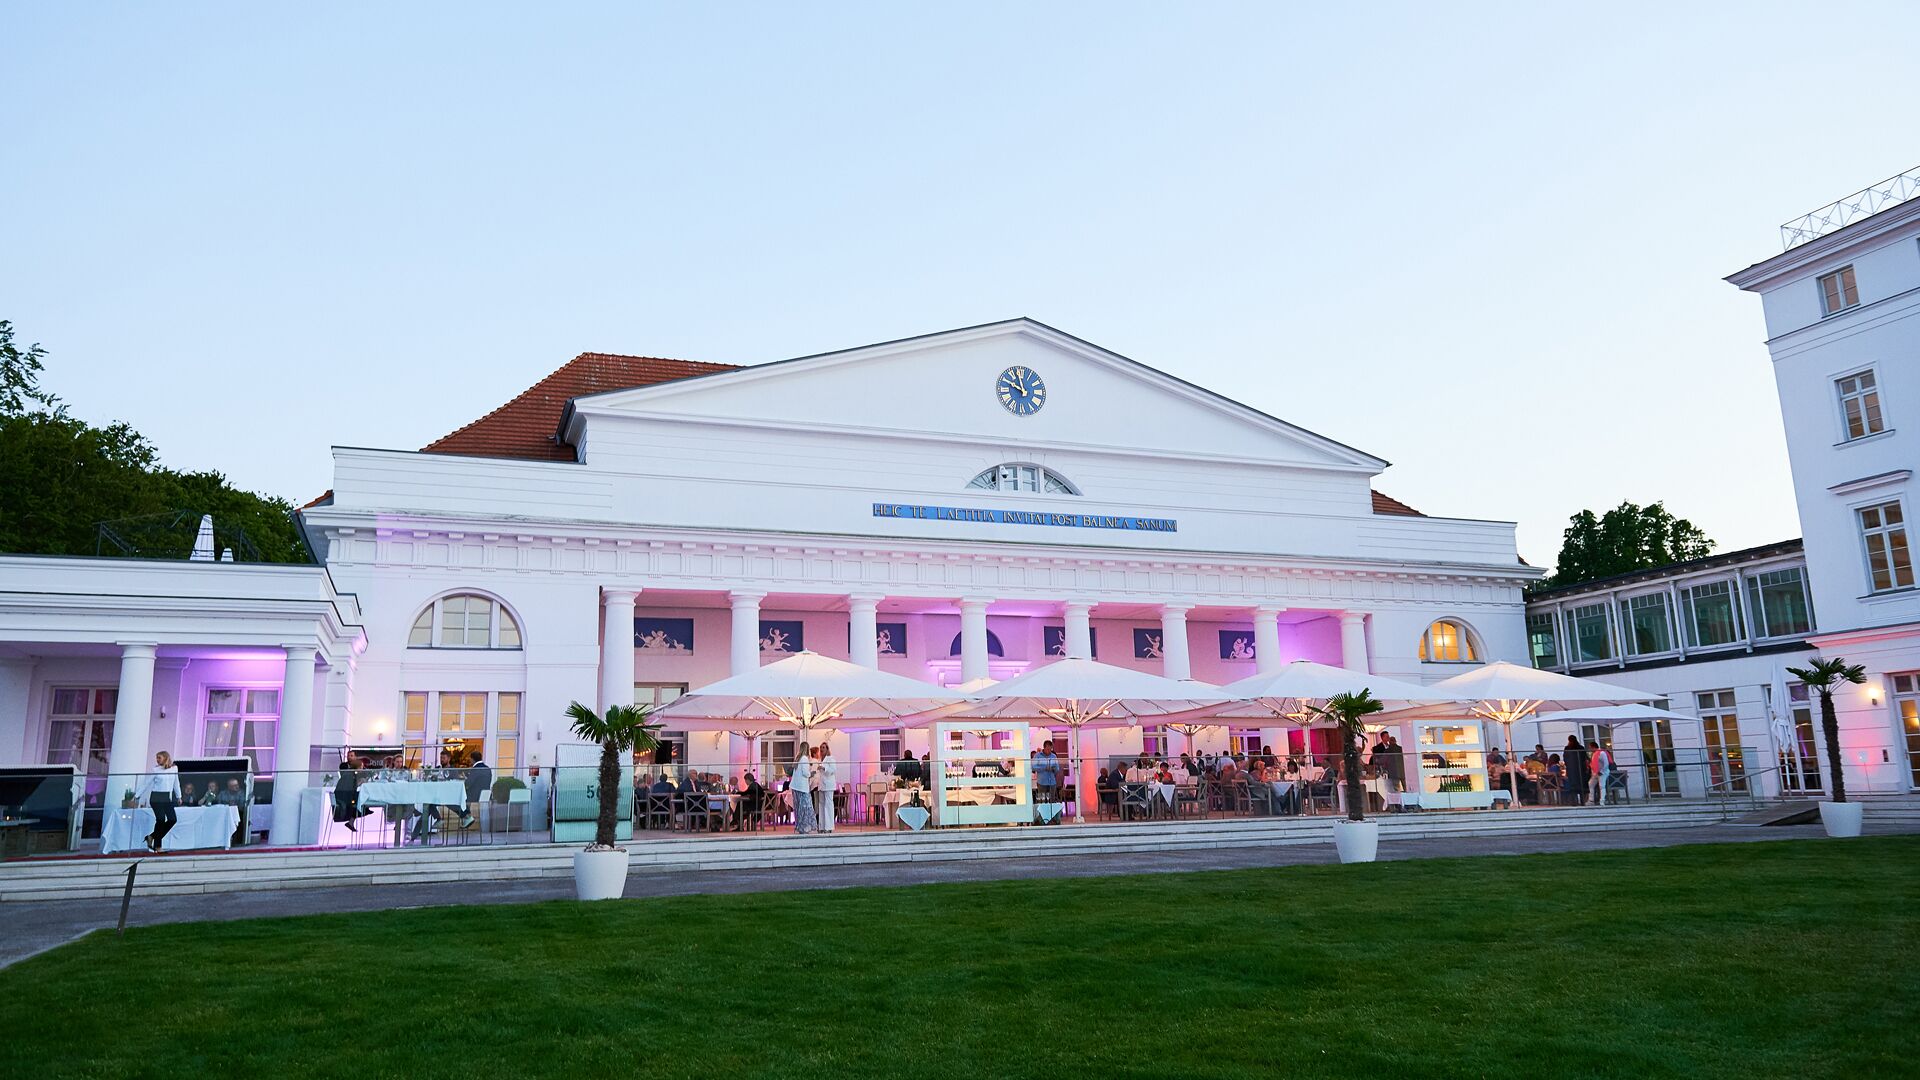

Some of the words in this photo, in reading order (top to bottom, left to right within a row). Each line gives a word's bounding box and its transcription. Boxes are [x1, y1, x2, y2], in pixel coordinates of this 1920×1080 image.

[873, 503, 902, 517] HEIC
[911, 505, 927, 519] TE
[937, 507, 995, 522] LAETITIA
[1002, 511, 1045, 525] INVITAT
[1051, 513, 1077, 527] POST
[1083, 515, 1129, 529] BALNEA
[1135, 518, 1178, 532] SANUM
